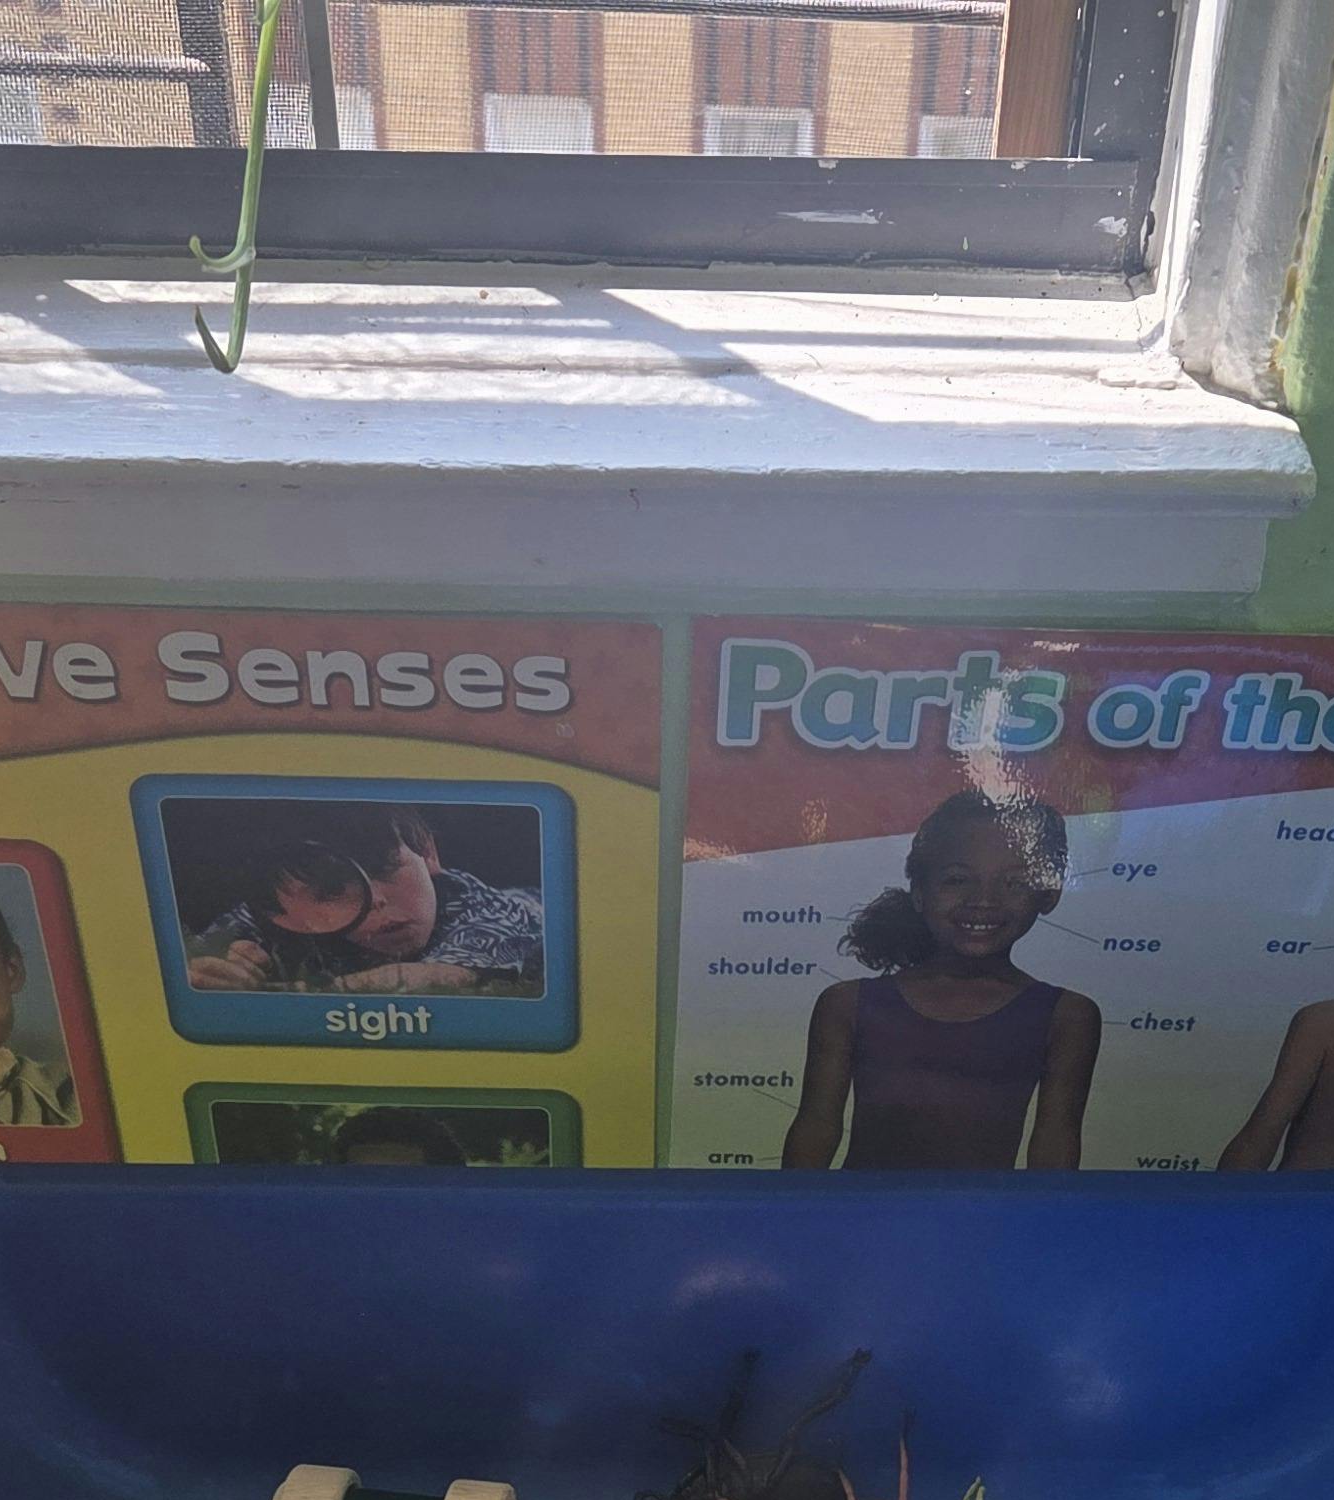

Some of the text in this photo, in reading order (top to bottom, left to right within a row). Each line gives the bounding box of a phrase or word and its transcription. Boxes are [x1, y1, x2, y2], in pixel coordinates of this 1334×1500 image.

[157, 630, 571, 712] Senses
[717, 639, 1067, 751] Parts
[1088, 669, 1212, 750] of
[1112, 861, 1158, 881] eye
[742, 905, 823, 925] mouth
[1102, 935, 1162, 954] nose
[1266, 937, 1311, 956] ear
[707, 957, 817, 976] shoulder
[326, 1003, 432, 1041] sight
[1130, 1014, 1196, 1033] chest
[693, 1070, 795, 1089] stomach
[708, 1149, 755, 1166] arm
[1137, 1155, 1200, 1171] waist
